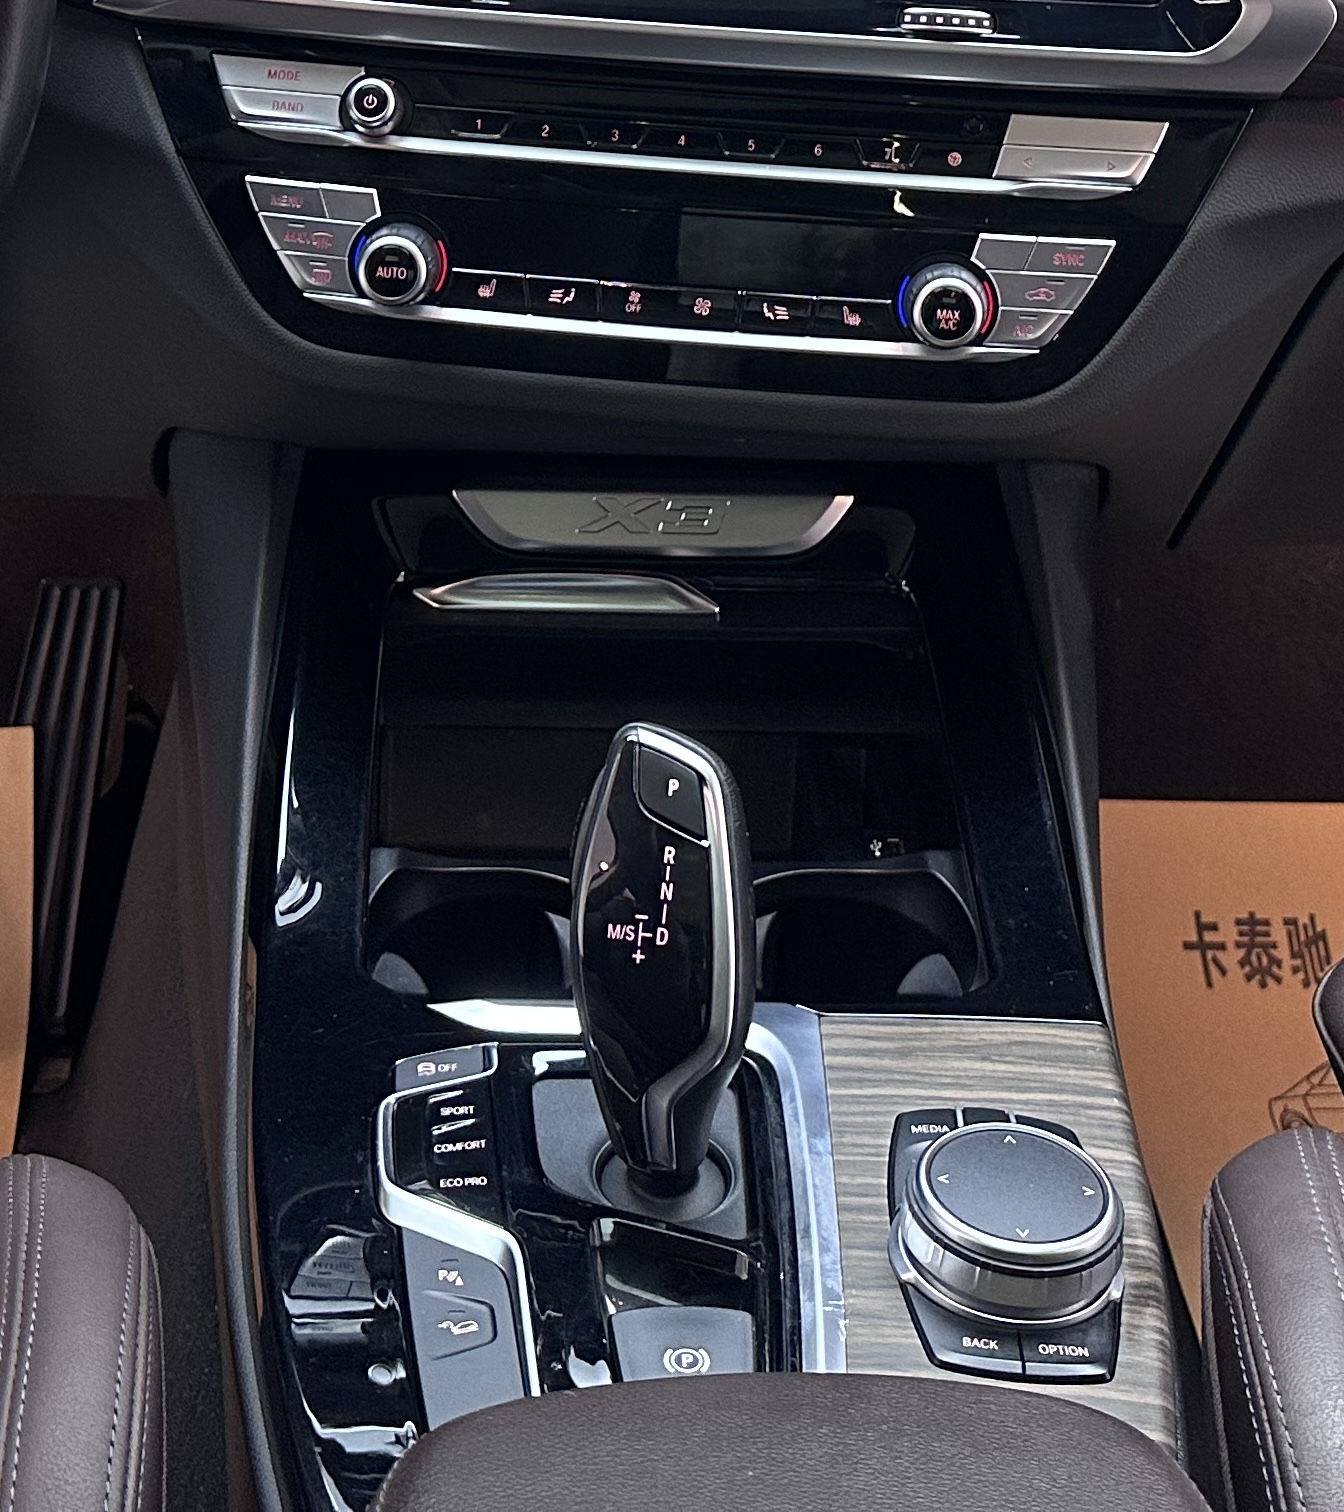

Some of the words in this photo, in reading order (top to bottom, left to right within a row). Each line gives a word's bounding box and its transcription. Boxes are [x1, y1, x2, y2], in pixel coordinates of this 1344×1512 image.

[267, 68, 301, 82] MODE
[1053, 253, 1086, 266] SYNC
[376, 266, 407, 280] AUTO
[625, 303, 642, 313] OFF
[936, 309, 961, 321] MAX
[939, 319, 958, 331] A/C
[575, 496, 731, 535] X3
[667, 778, 680, 797] P
[663, 846, 675, 864] R
[660, 883, 673, 901] N
[607, 924, 636, 942] M/S
[655, 927, 669, 946] D
[438, 1062, 459, 1073] OFF
[440, 1104, 475, 1117] SPORT
[910, 1123, 951, 1134] MEDIA
[433, 1139, 487, 1154] COMFORT
[439, 1176, 463, 1188] ECO
[464, 1175, 488, 1187] PRO
[962, 1336, 999, 1351] BACK
[1038, 1343, 1090, 1358] OPTION
